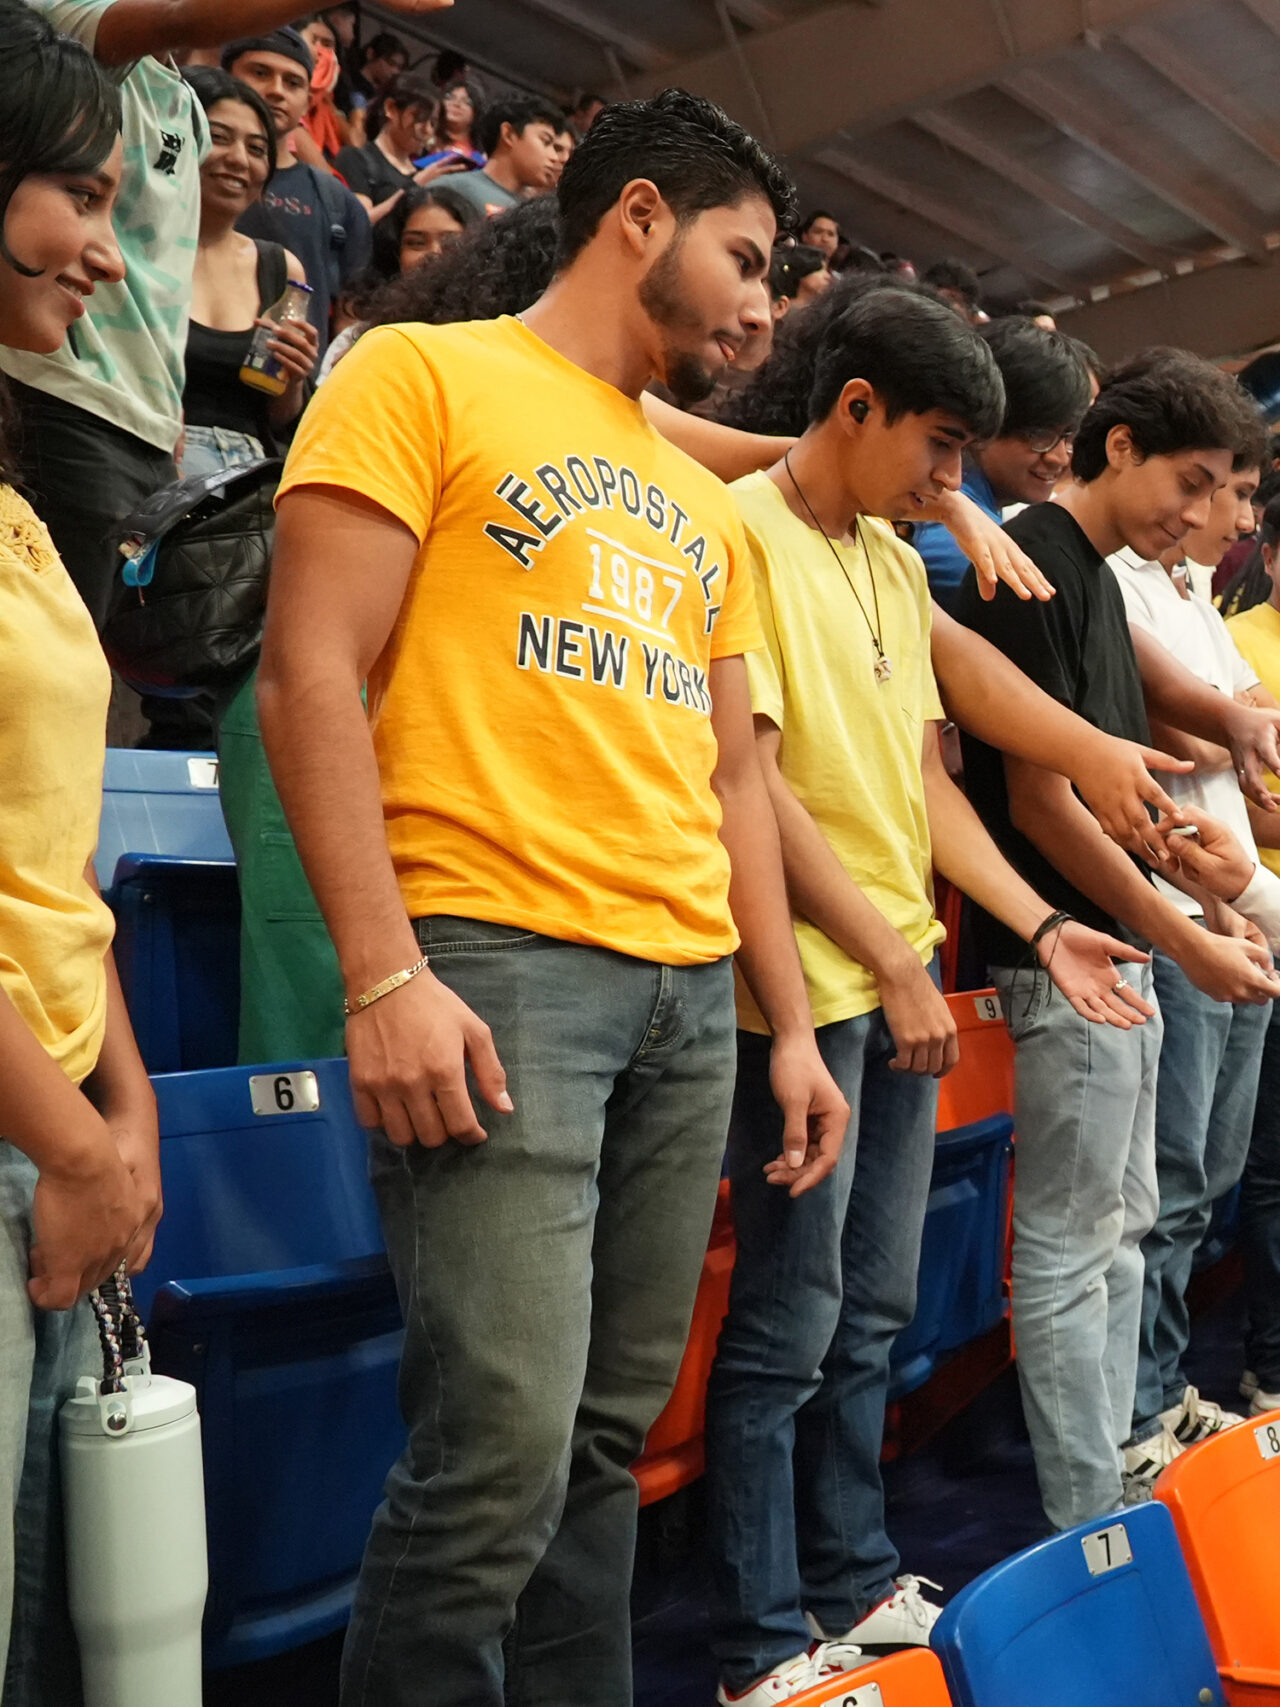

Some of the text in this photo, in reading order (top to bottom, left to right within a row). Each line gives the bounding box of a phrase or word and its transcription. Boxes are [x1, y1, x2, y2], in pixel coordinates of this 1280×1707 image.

[588, 543, 683, 629] 1987
[517, 611, 713, 717] NEW YORK
[984, 998, 996, 1018] 9
[273, 1076, 294, 1111] 6
[1266, 1426, 1280, 1453] 8
[1097, 1532, 1111, 1567] 7
